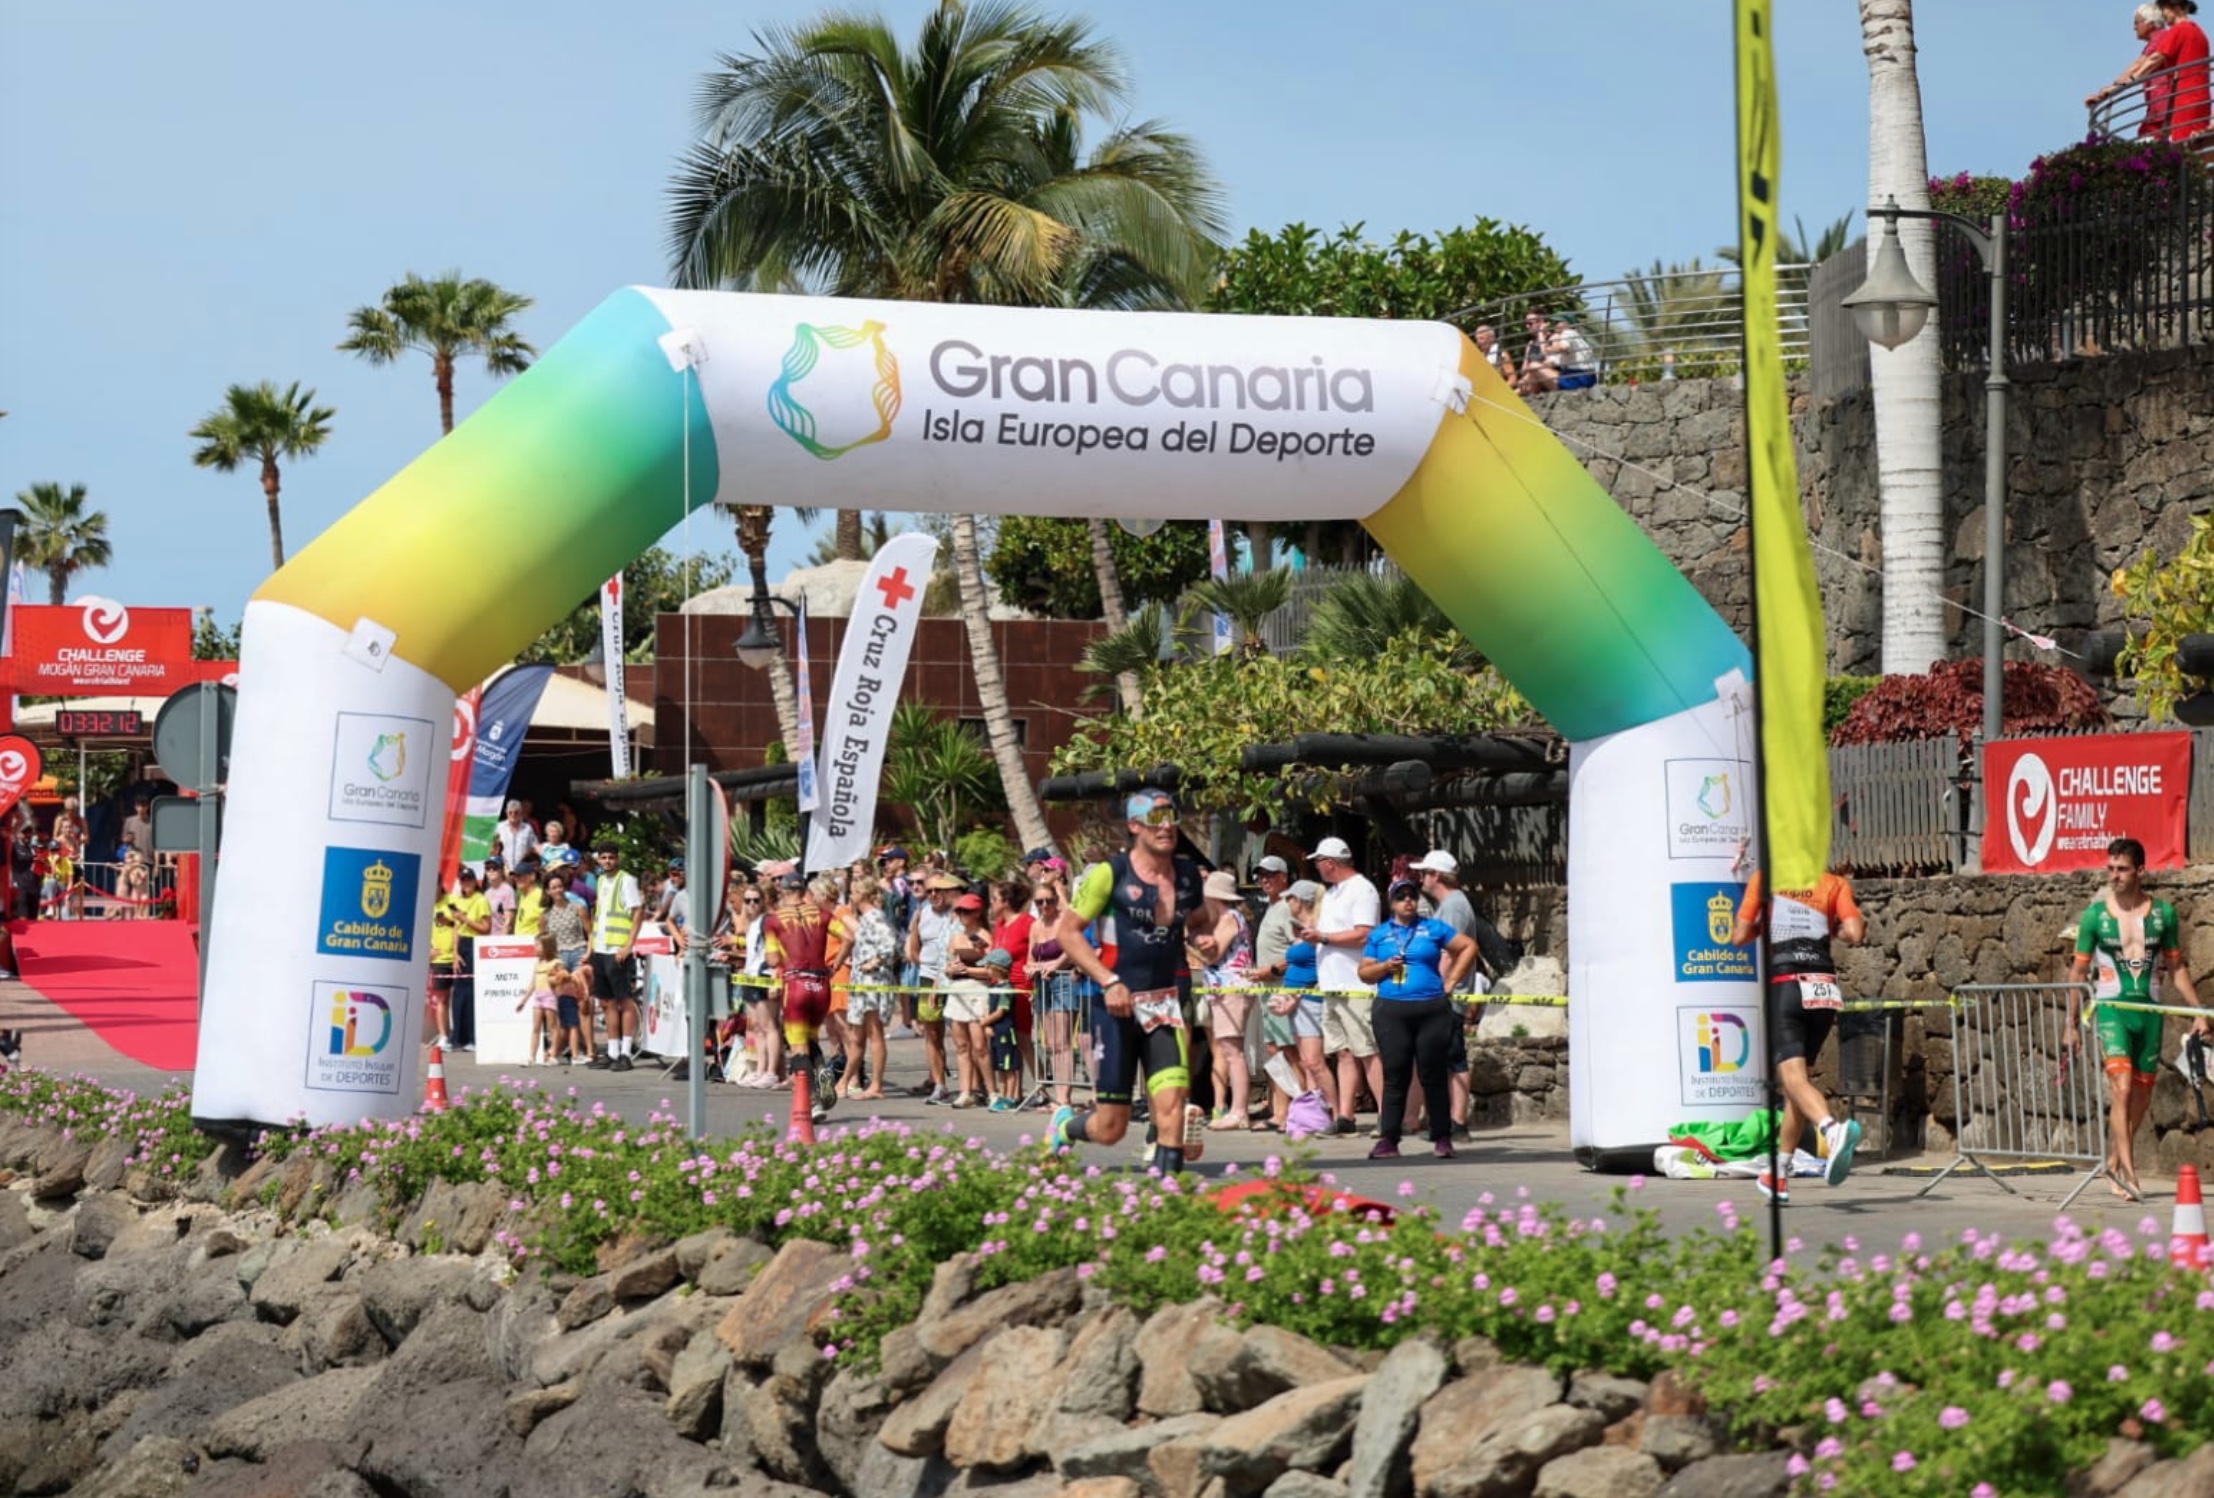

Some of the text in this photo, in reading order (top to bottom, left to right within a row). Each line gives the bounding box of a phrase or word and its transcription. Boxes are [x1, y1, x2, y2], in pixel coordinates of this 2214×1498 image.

[929, 340, 1374, 413] Gran Canaria
[922, 409, 1375, 461] Isla Europea del Deporte
[58, 648, 146, 662] CHALLENGE
[83, 663, 115, 677] GRAN
[117, 664, 166, 677] CANARIA
[829, 613, 898, 839] Cruz Roja Española
[2060, 765, 2162, 796] CHALLENGE
[344, 783, 376, 797] Gran
[2058, 802, 2107, 829] FAMILY
[1679, 823, 1709, 835] Gran
[334, 920, 403, 938] Cabildo de
[325, 933, 408, 953] Gran Canaria
[1688, 948, 1748, 961] Cabildo de
[1682, 962, 1754, 975] Gran Canaria
[336, 1070, 391, 1086] DEPORTES
[1709, 1086, 1755, 1098] DEPORTES
